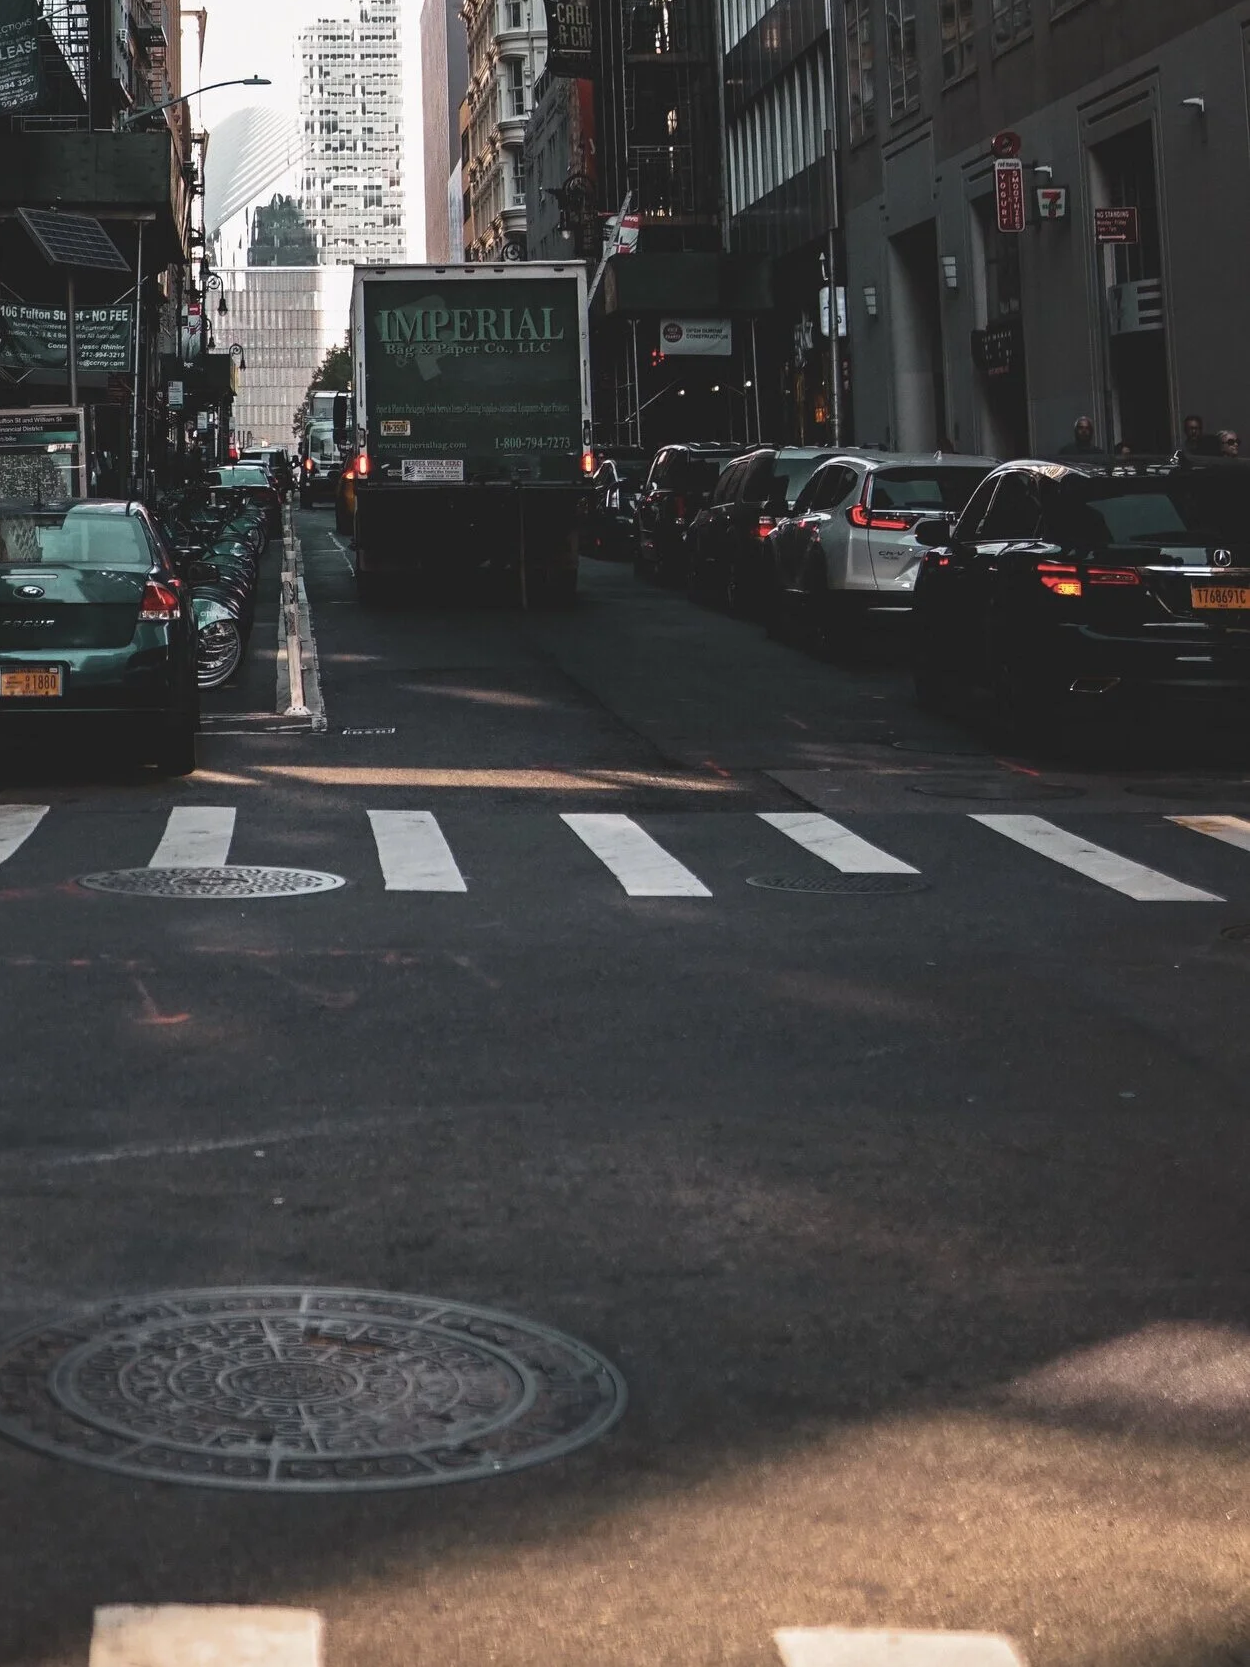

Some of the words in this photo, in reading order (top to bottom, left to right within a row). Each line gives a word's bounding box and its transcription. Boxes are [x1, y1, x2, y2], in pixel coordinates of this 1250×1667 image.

[999, 172, 1009, 225] YOGURT
[1011, 170, 1021, 230] SMOOTHIES
[1105, 211, 1129, 219] STANDING
[0, 305, 18, 318] 106
[20, 307, 51, 320] Fulton
[53, 310, 85, 322] Stret
[92, 310, 107, 322] NO
[109, 309, 128, 322] FEE
[379, 307, 564, 343] IMPERIAL
[385, 344, 414, 357] Bag
[419, 343, 432, 355] &
[437, 343, 479, 357] Paper
[518, 342, 552, 354] LLC
[378, 440, 467, 452] www.imperialbag.com
[494, 436, 571, 450] 1-800-794-7273
